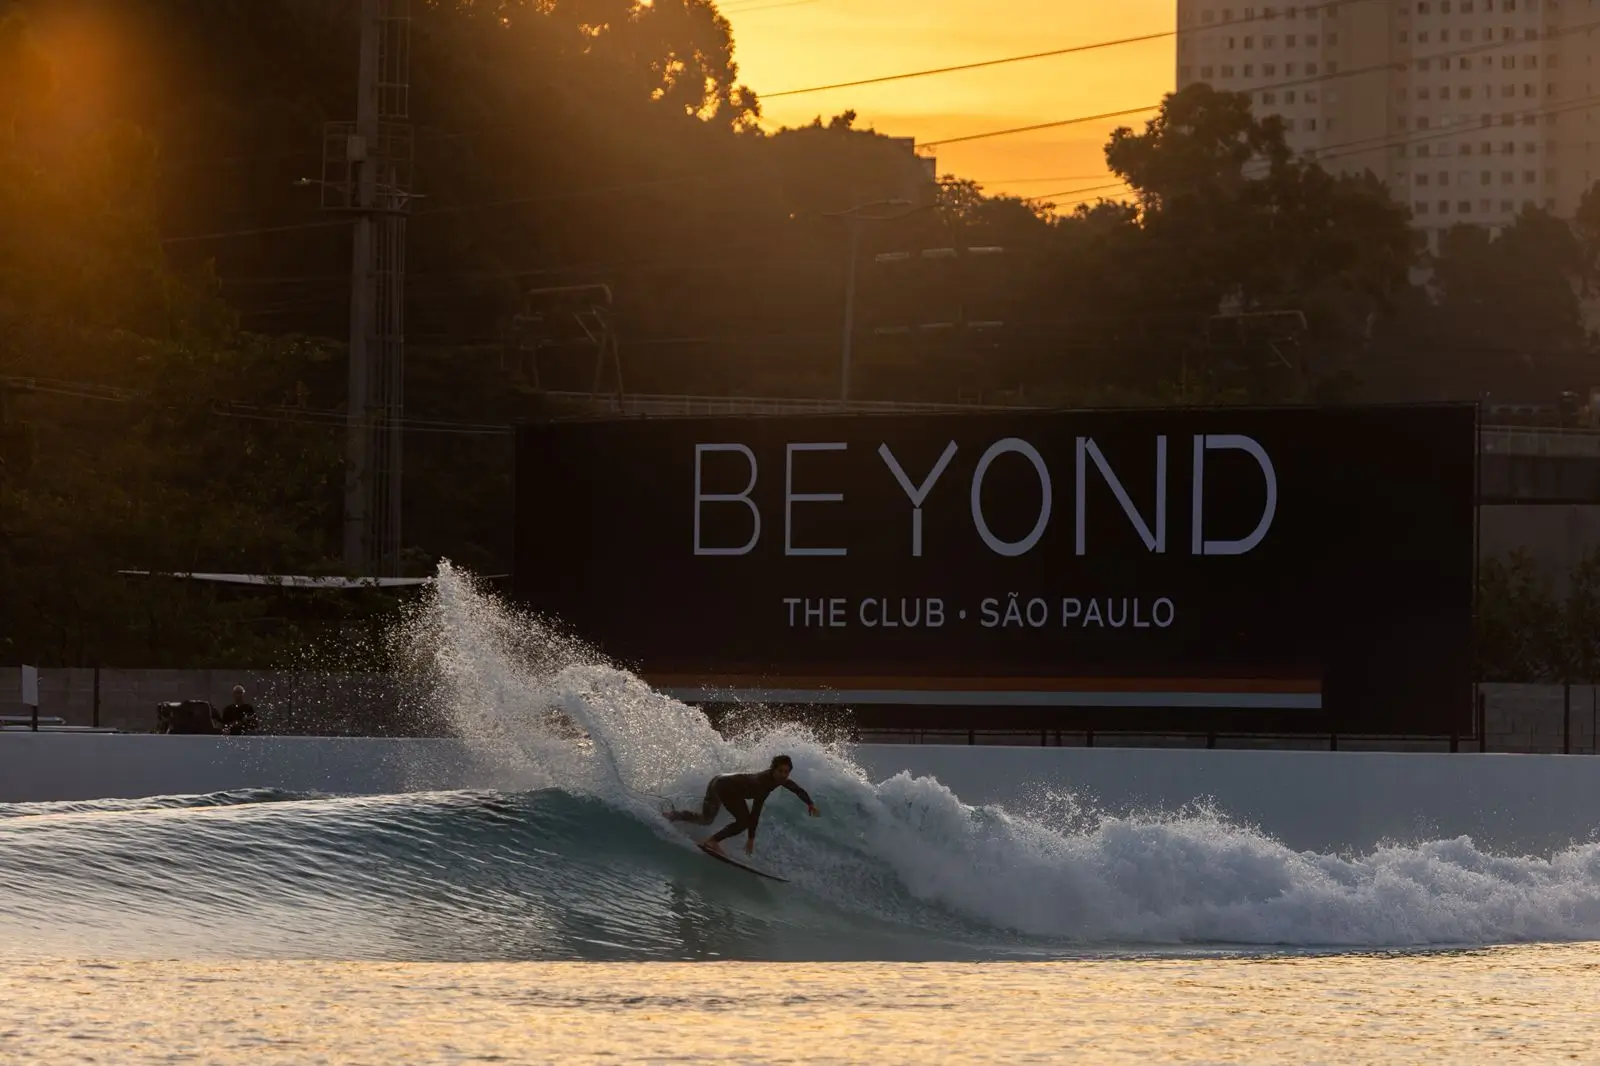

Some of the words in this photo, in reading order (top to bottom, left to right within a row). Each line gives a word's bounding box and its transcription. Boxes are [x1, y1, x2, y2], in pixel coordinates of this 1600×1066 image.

[693, 434, 1277, 557] BEYOND
[783, 598, 847, 627] THE
[859, 598, 945, 627] CLUB
[980, 591, 1048, 627] SÃO
[1062, 598, 1175, 628] PAULO
